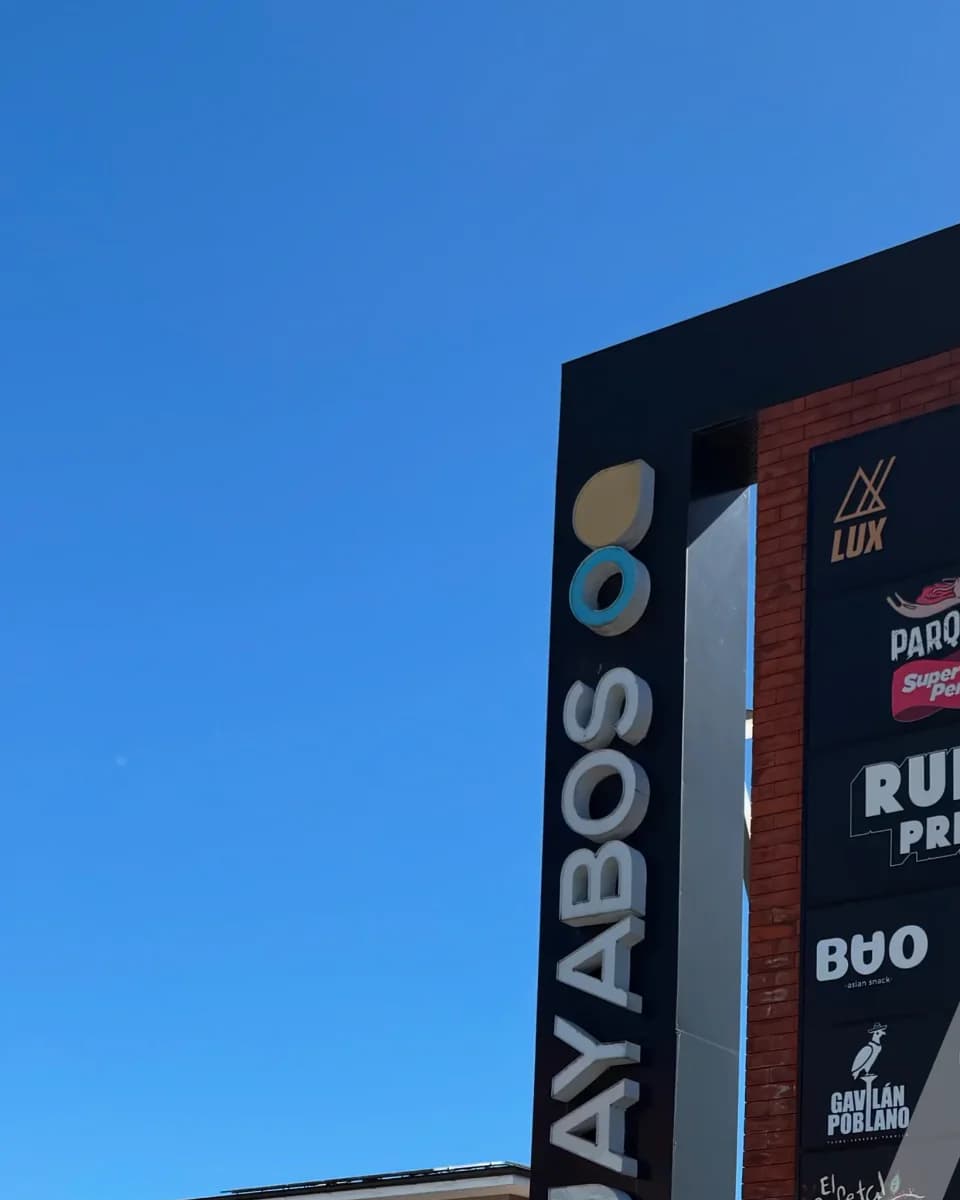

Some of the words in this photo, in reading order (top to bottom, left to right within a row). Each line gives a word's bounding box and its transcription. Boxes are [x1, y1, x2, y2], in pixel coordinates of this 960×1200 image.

[830, 516, 887, 563] LUX
[902, 666, 960, 693] Super
[830, 1082, 906, 1114] GAVILÁN
[827, 1107, 911, 1136] POBLANO
[820, 1173, 836, 1195] El
